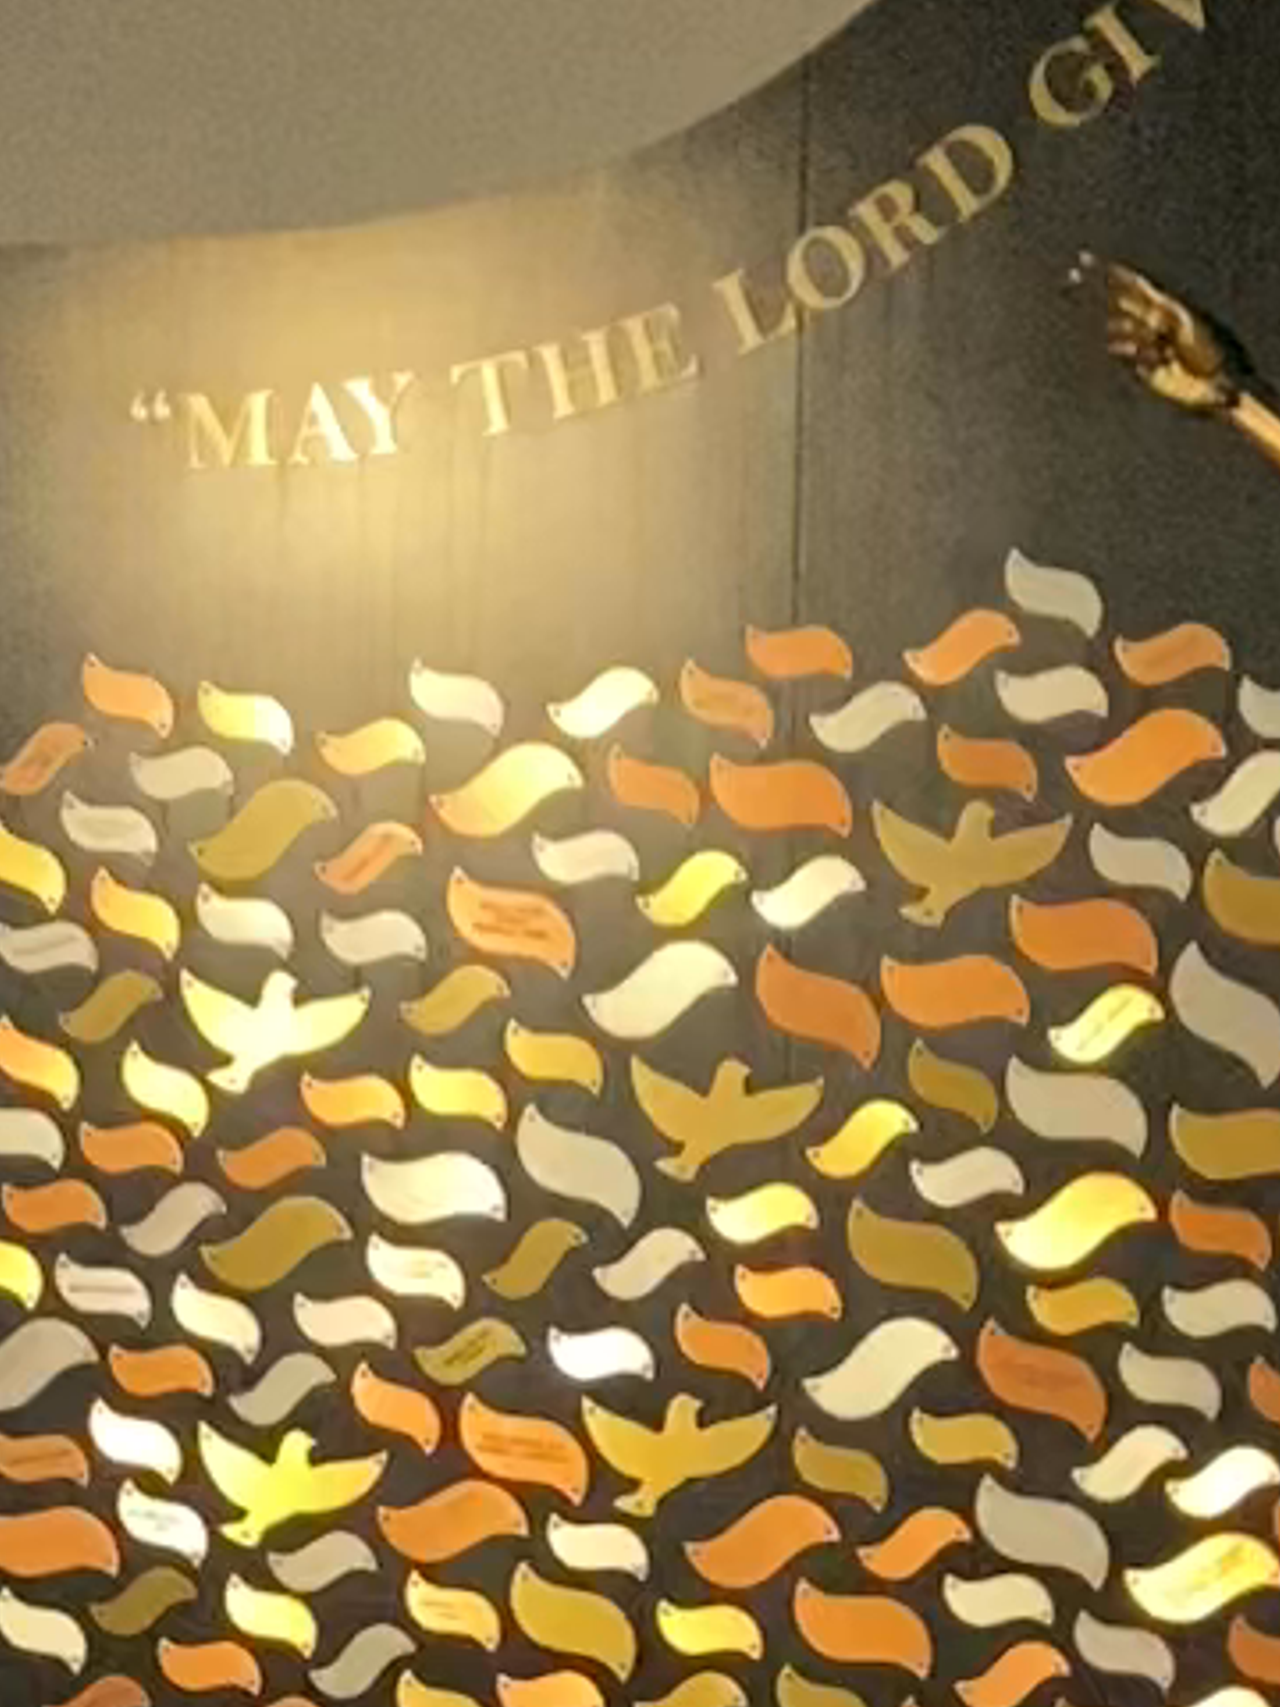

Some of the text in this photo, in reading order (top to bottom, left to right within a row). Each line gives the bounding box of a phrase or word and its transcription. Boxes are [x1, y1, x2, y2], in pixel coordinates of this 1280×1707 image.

[129, 369, 416, 469] "MAY
[449, 302, 703, 437] THE
[713, 124, 1013, 356] LORD
